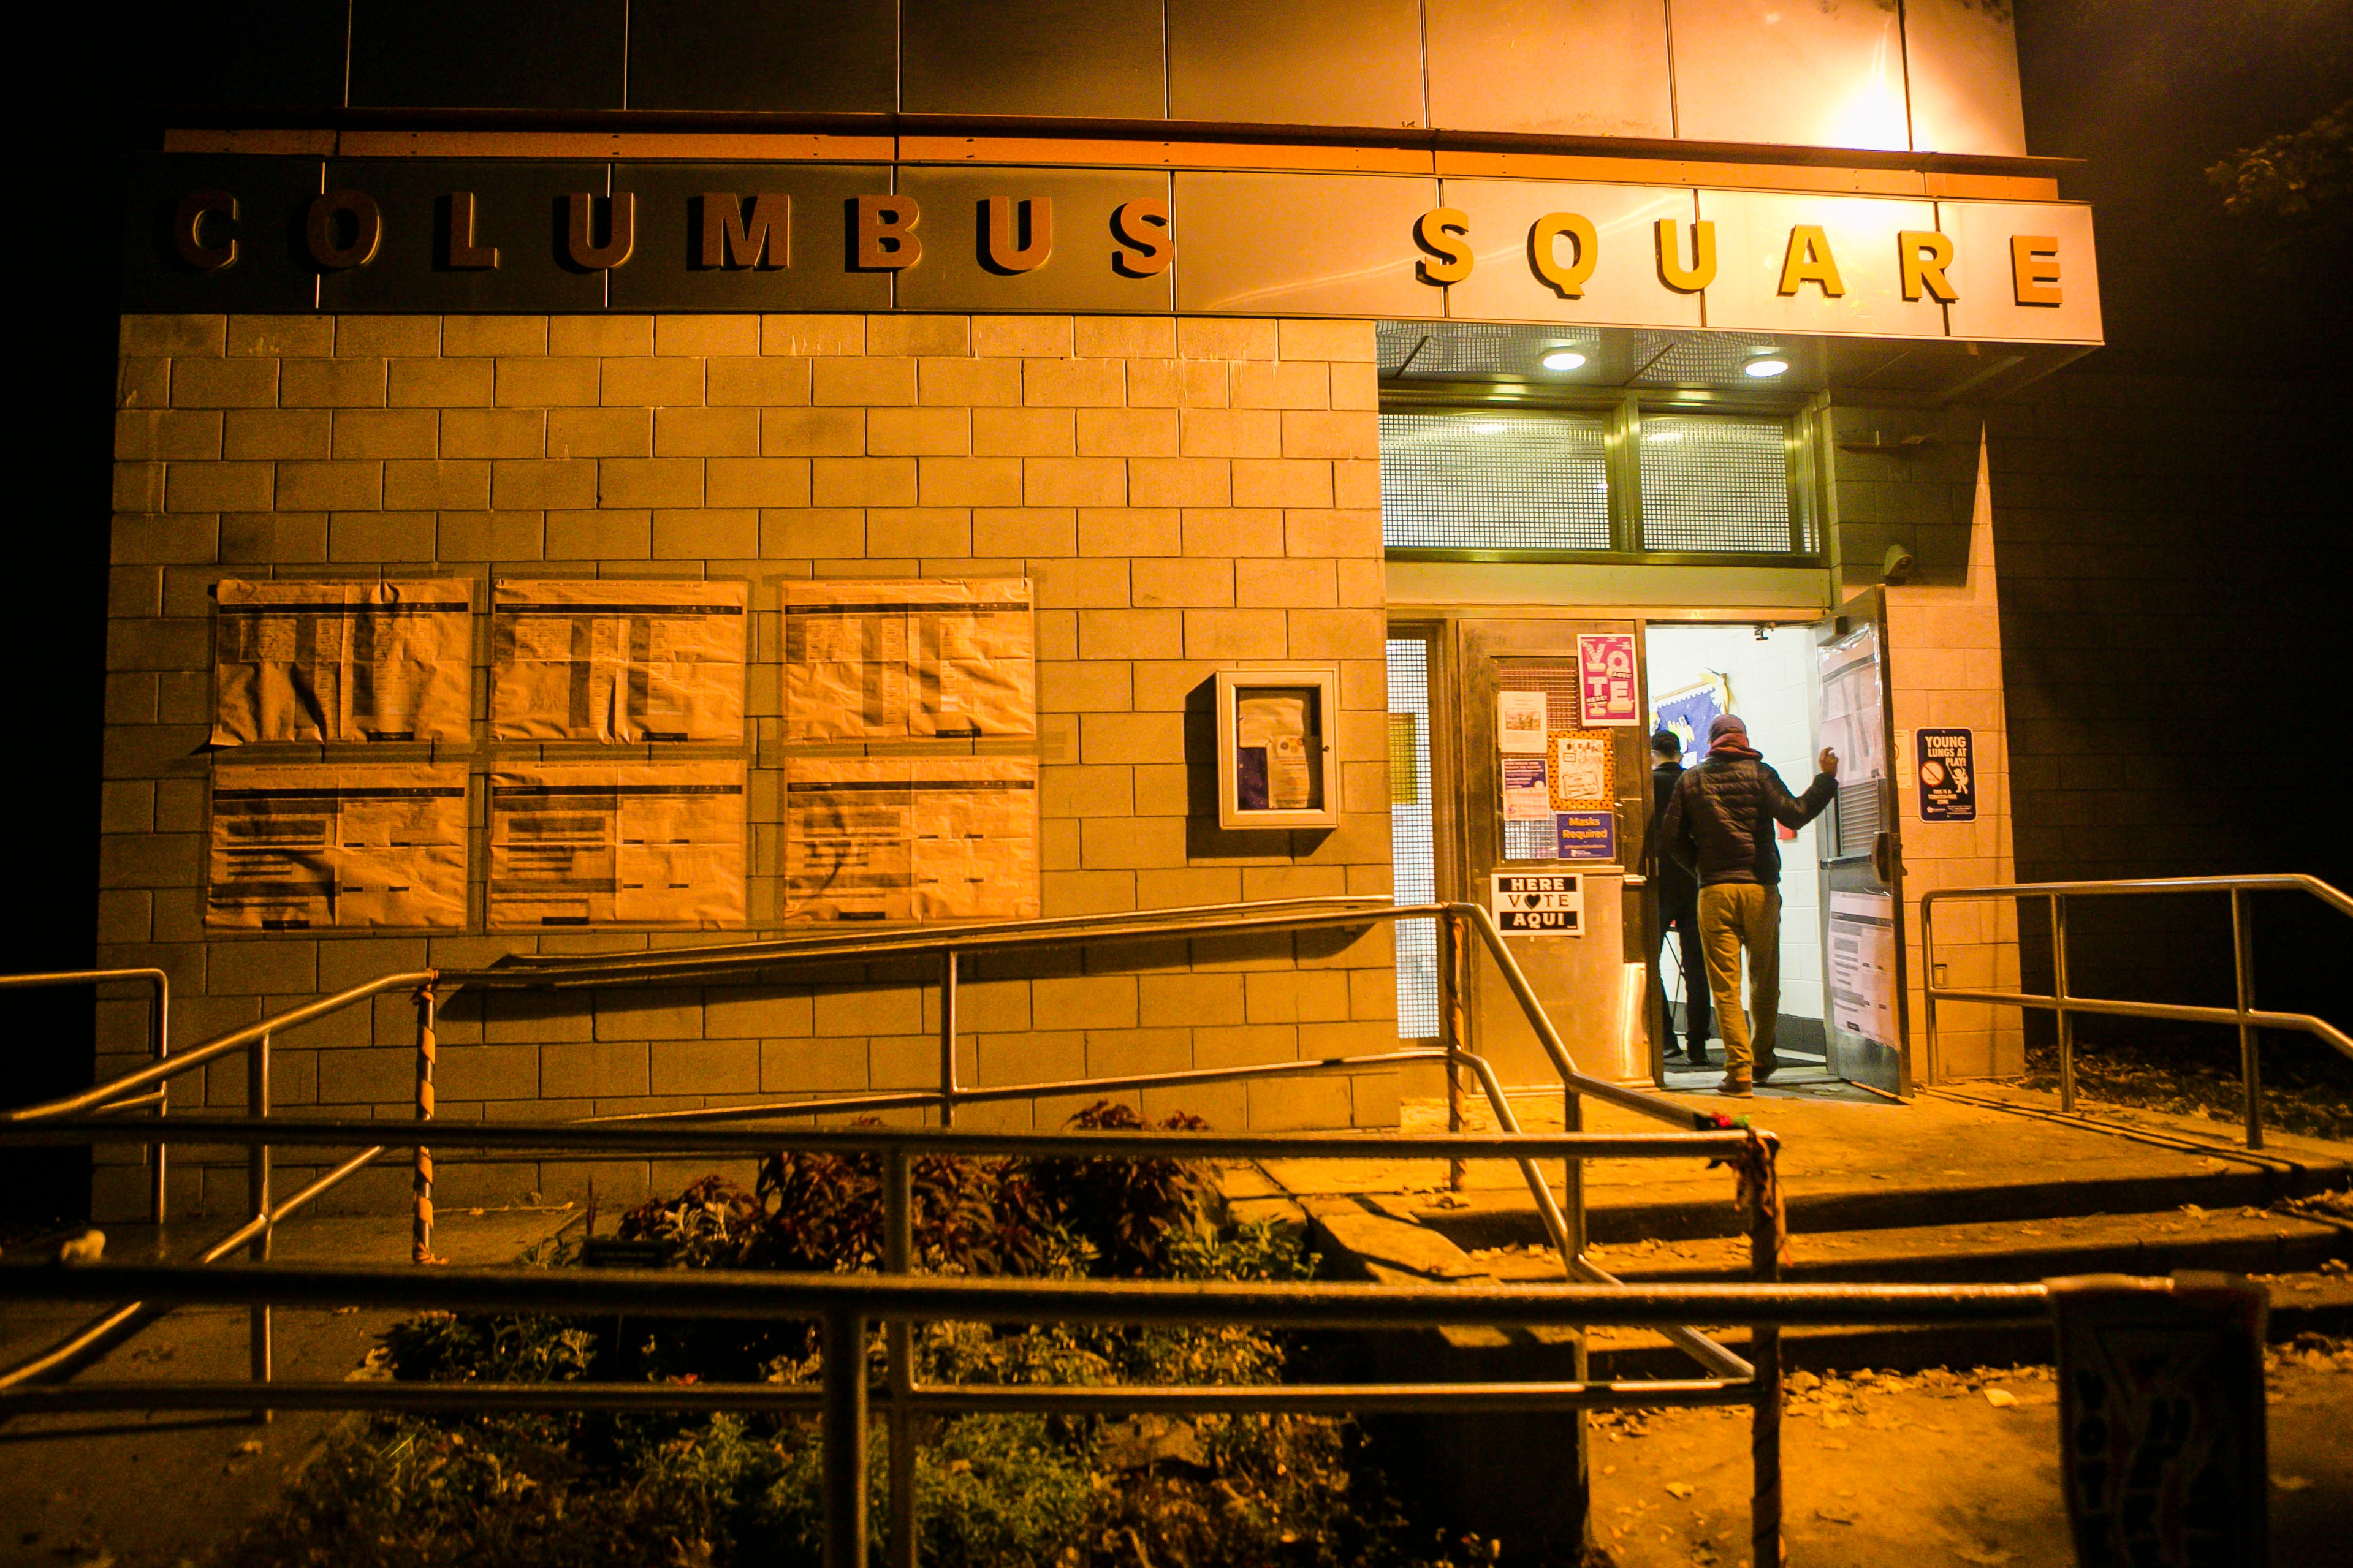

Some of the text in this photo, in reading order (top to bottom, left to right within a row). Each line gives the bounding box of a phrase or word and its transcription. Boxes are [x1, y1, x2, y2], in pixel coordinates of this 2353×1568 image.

[174, 190, 2064, 305] COLUMBUS SQUARE
[1925, 736, 1967, 748] YOUNG
[1928, 748, 1967, 757] LUNGS AT
[1945, 757, 1967, 767] PLAY!
[1568, 817, 1601, 827] Masks
[1562, 828, 1608, 840] Required
[1511, 878, 1565, 892] HERE
[1513, 912, 1565, 929] AQUI
